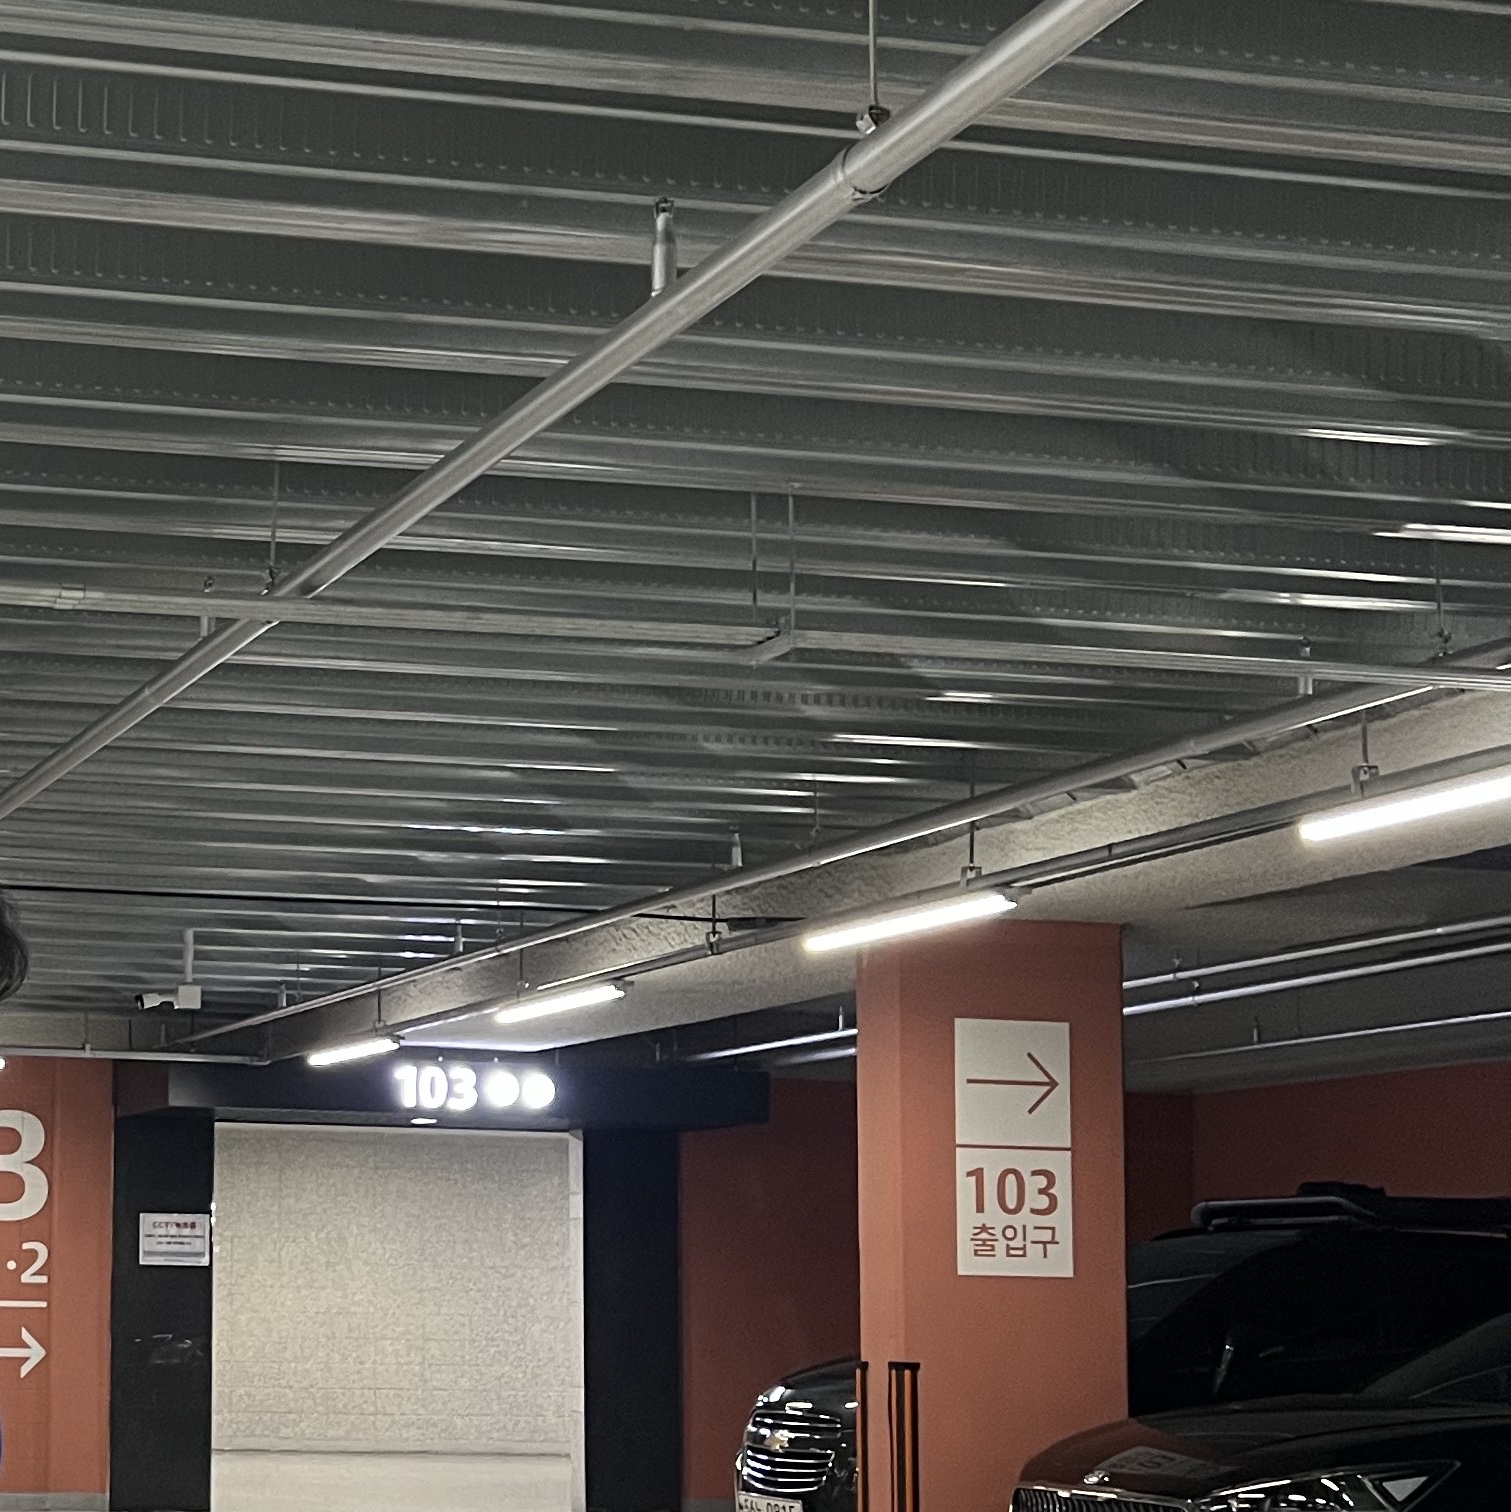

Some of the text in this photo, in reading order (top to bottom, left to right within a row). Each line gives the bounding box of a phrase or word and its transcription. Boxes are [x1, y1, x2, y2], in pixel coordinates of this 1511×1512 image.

[393, 1065, 479, 1111] 103
[965, 1166, 1059, 1217] 103
[970, 1223, 1060, 1259] 출입구
